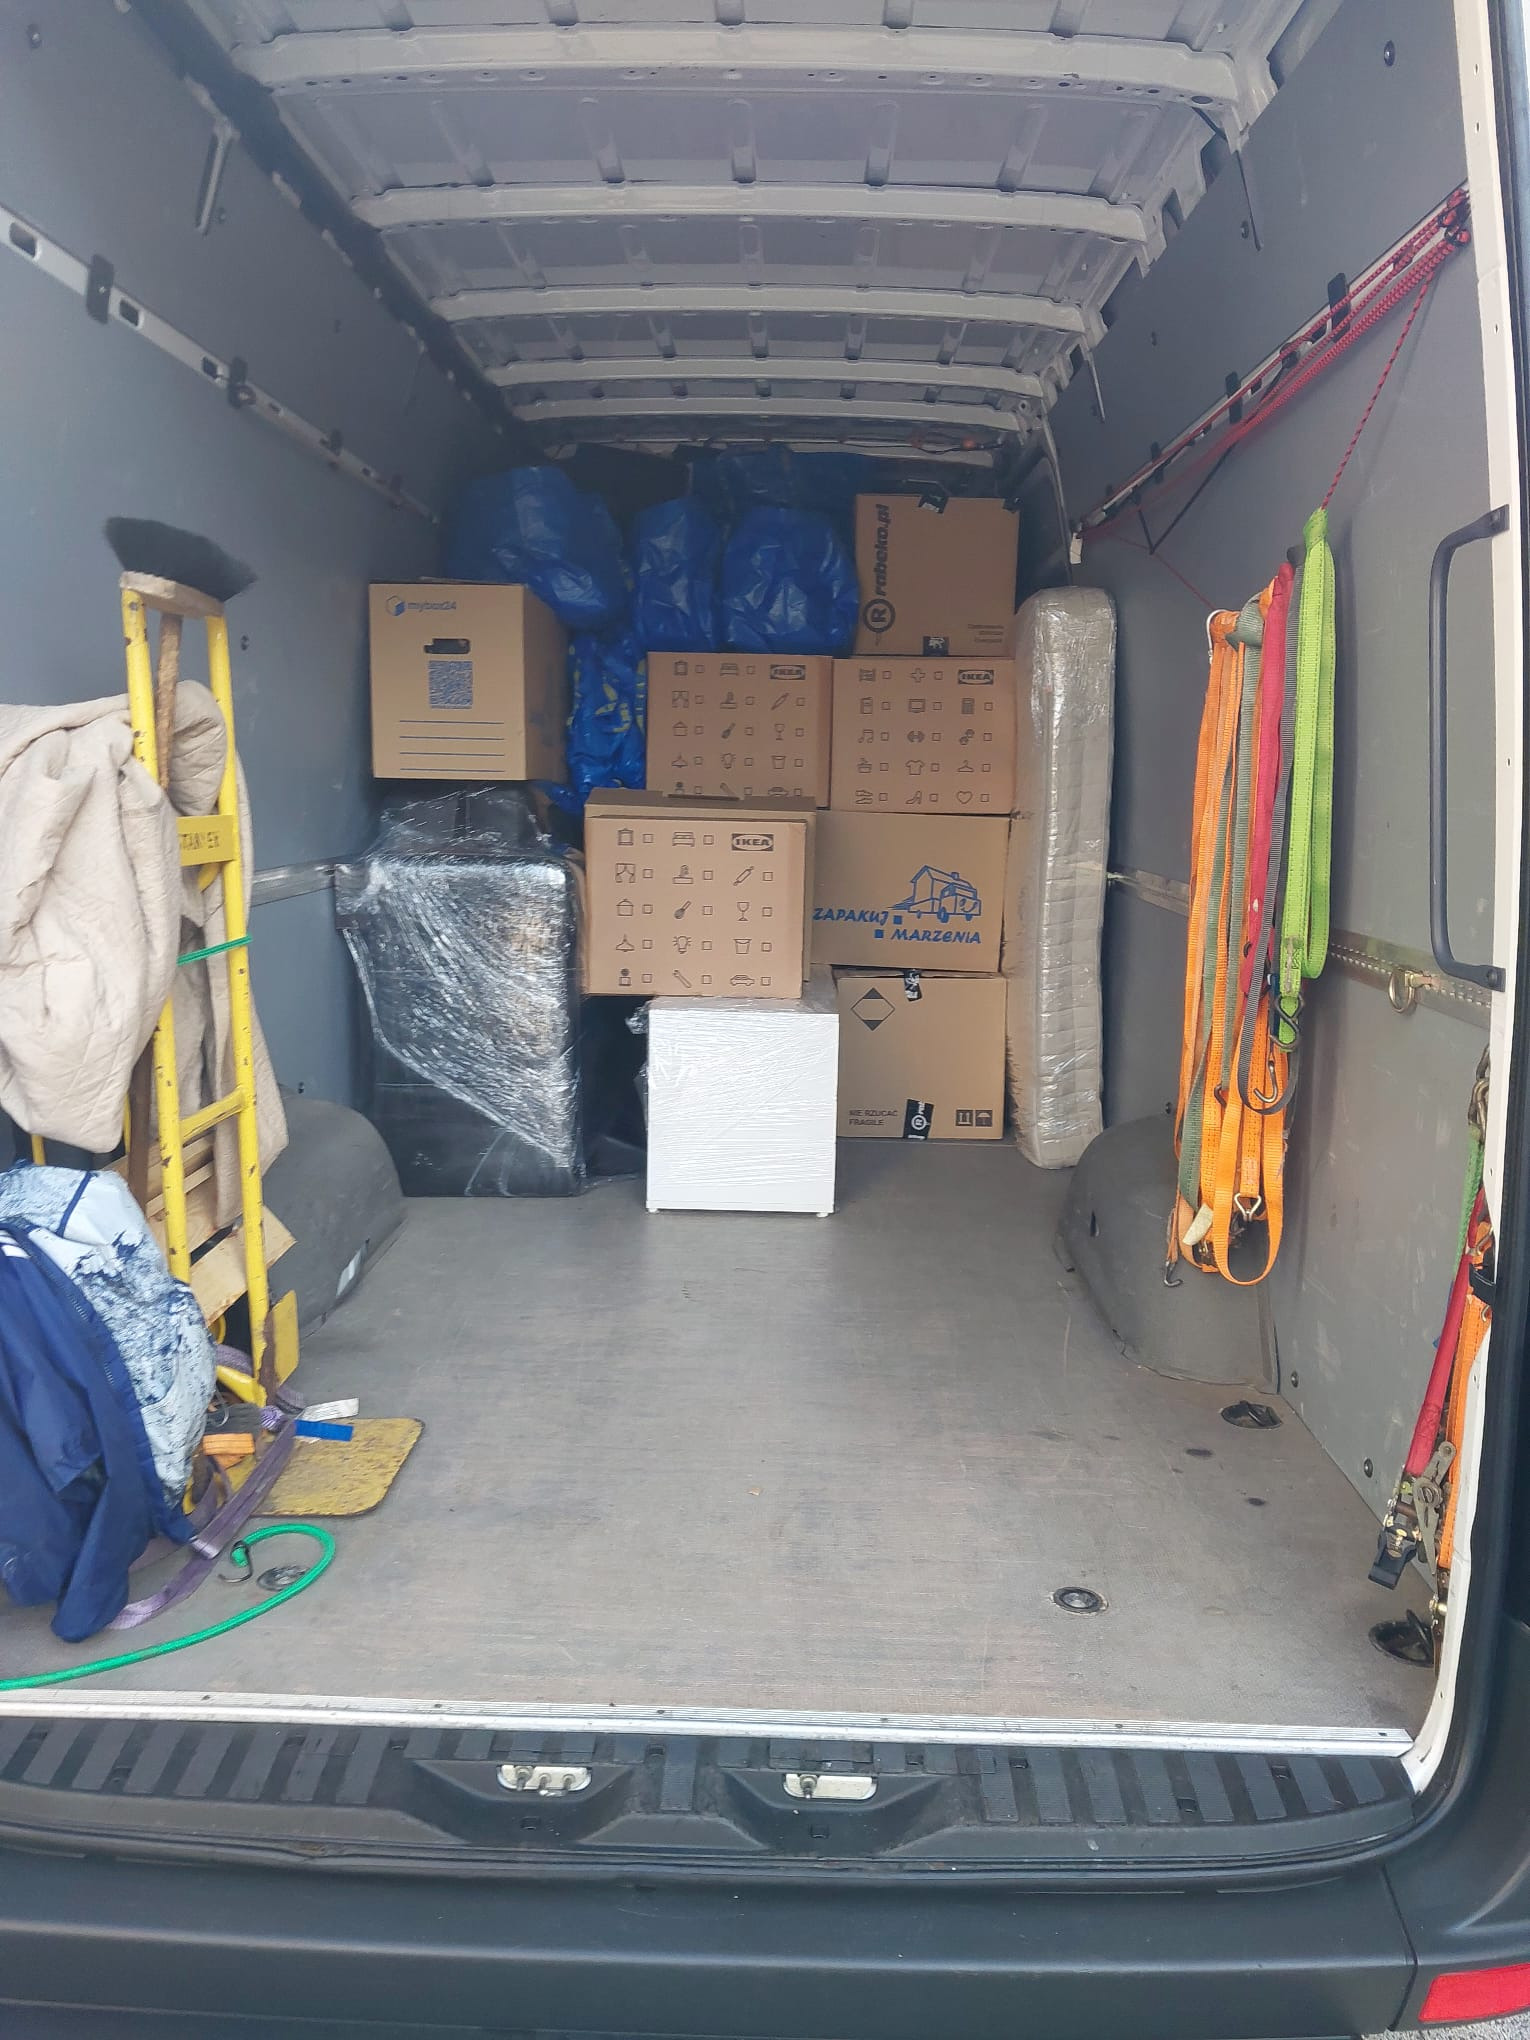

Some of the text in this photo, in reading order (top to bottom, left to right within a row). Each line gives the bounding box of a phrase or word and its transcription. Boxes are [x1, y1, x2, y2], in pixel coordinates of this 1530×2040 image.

[772, 667, 804, 678] IKEA
[960, 672, 992, 682] IKEA
[735, 837, 771, 848] IKEA
[812, 907, 889, 926] ZAPAKUJ
[890, 928, 982, 945] MARZENIA
[849, 1118, 885, 1126] FRAGILE
